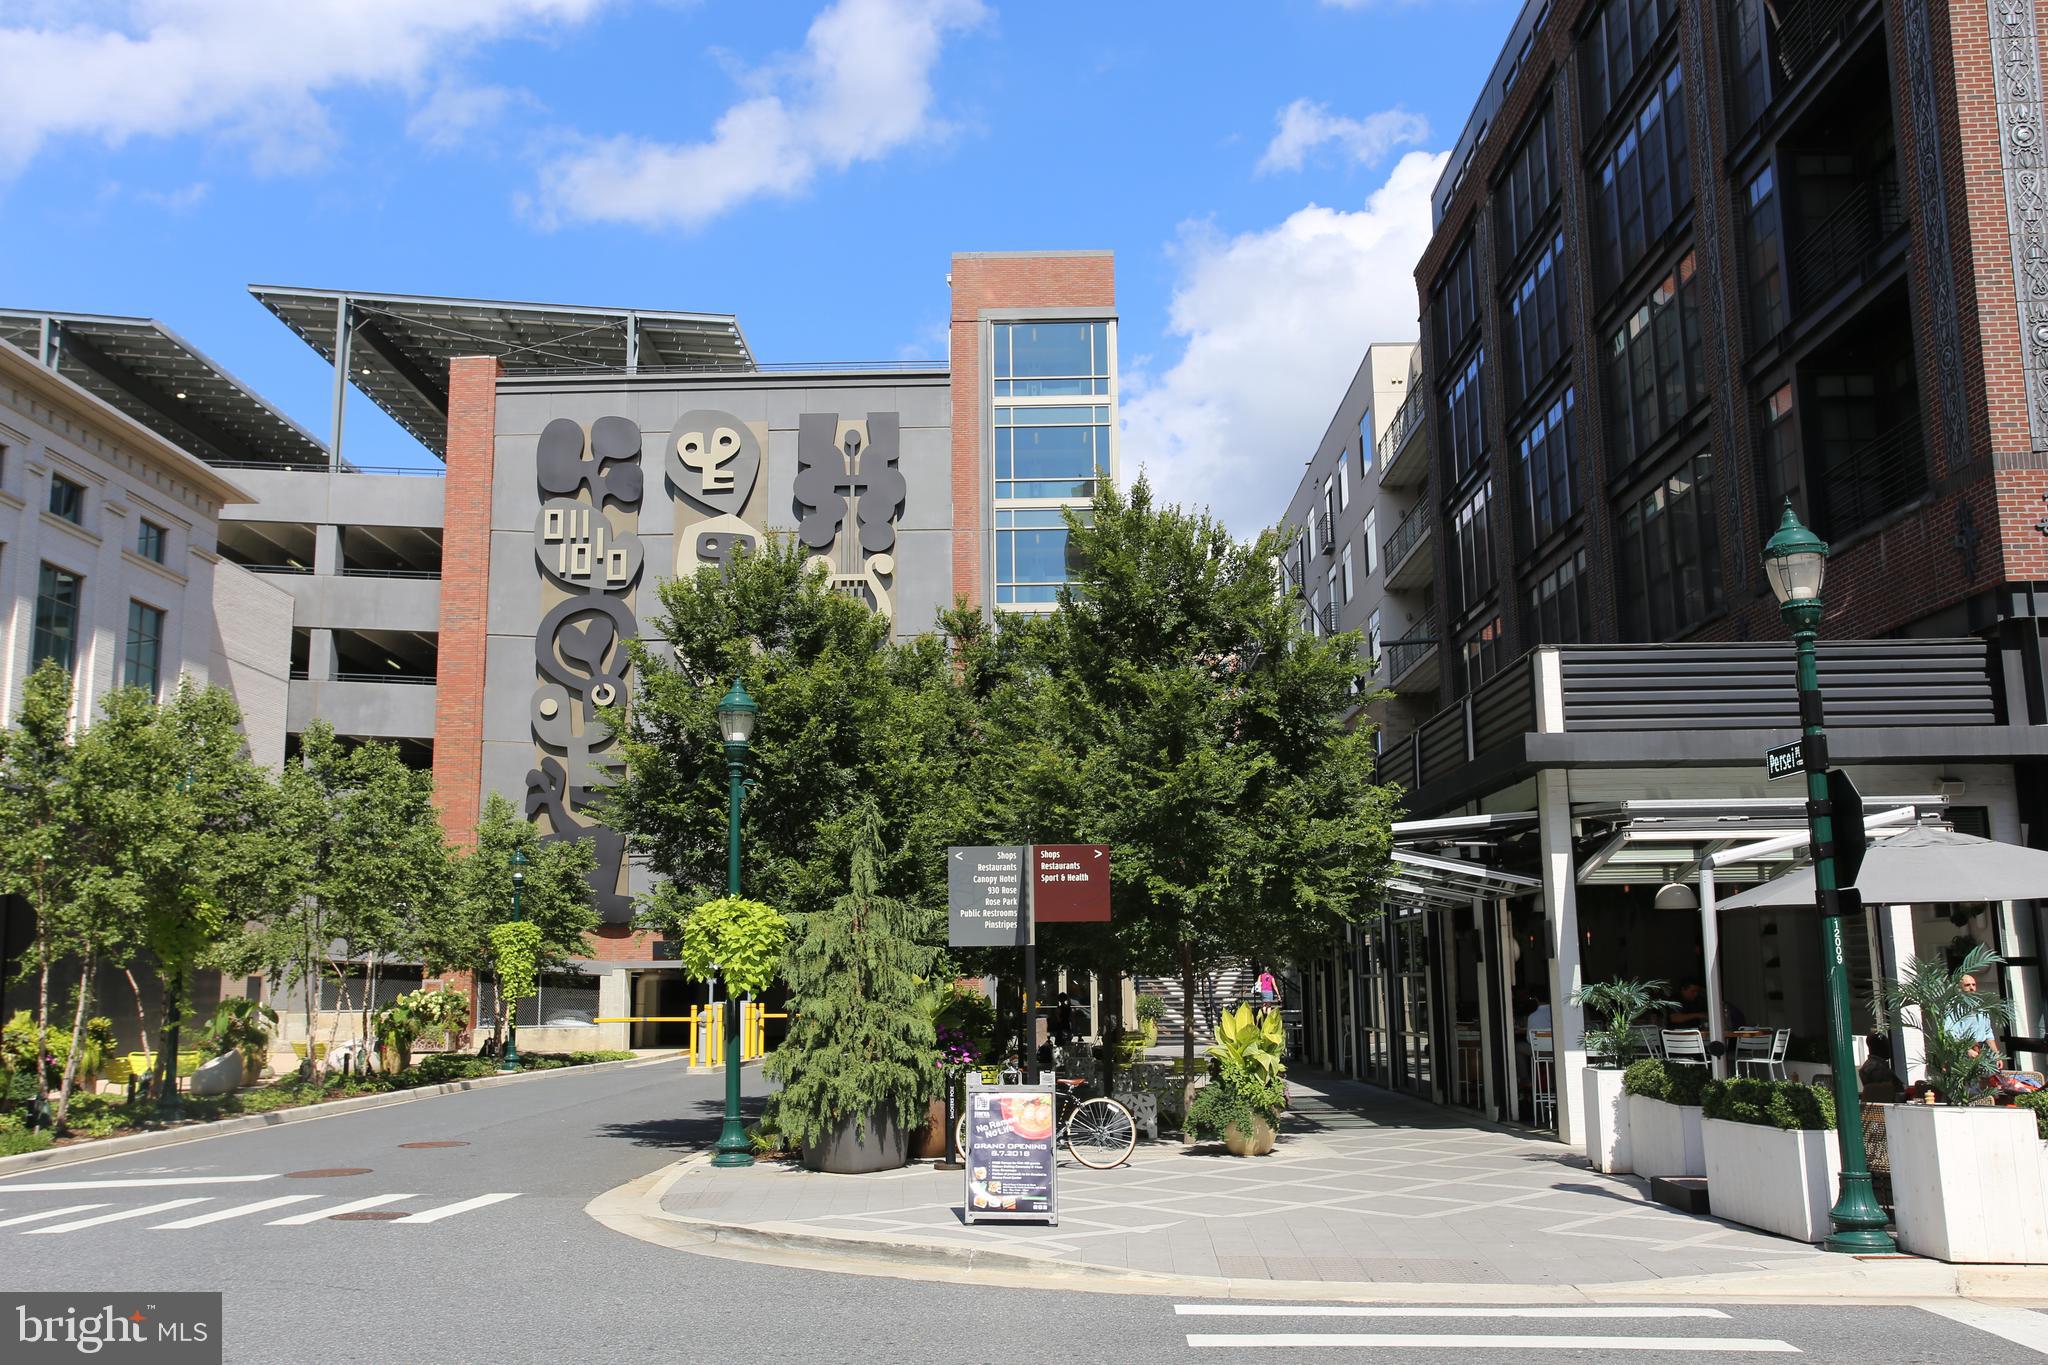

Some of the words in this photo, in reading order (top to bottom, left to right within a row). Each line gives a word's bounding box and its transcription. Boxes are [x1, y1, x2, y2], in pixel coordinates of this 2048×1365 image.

[1770, 747, 1795, 774] Persei
[997, 852, 1016, 860] Shops
[1040, 850, 1060, 860] Shops
[973, 876, 997, 885] Canopy
[1041, 874, 1059, 883] Sport
[1067, 873, 1088, 881] Health
[960, 909, 980, 917] Public
[985, 920, 1018, 930] Pinstripes
[1834, 920, 1842, 964] 12009
[976, 1124, 988, 1133] No
[985, 1130, 998, 1138] No
[998, 1126, 1015, 1135] Life
